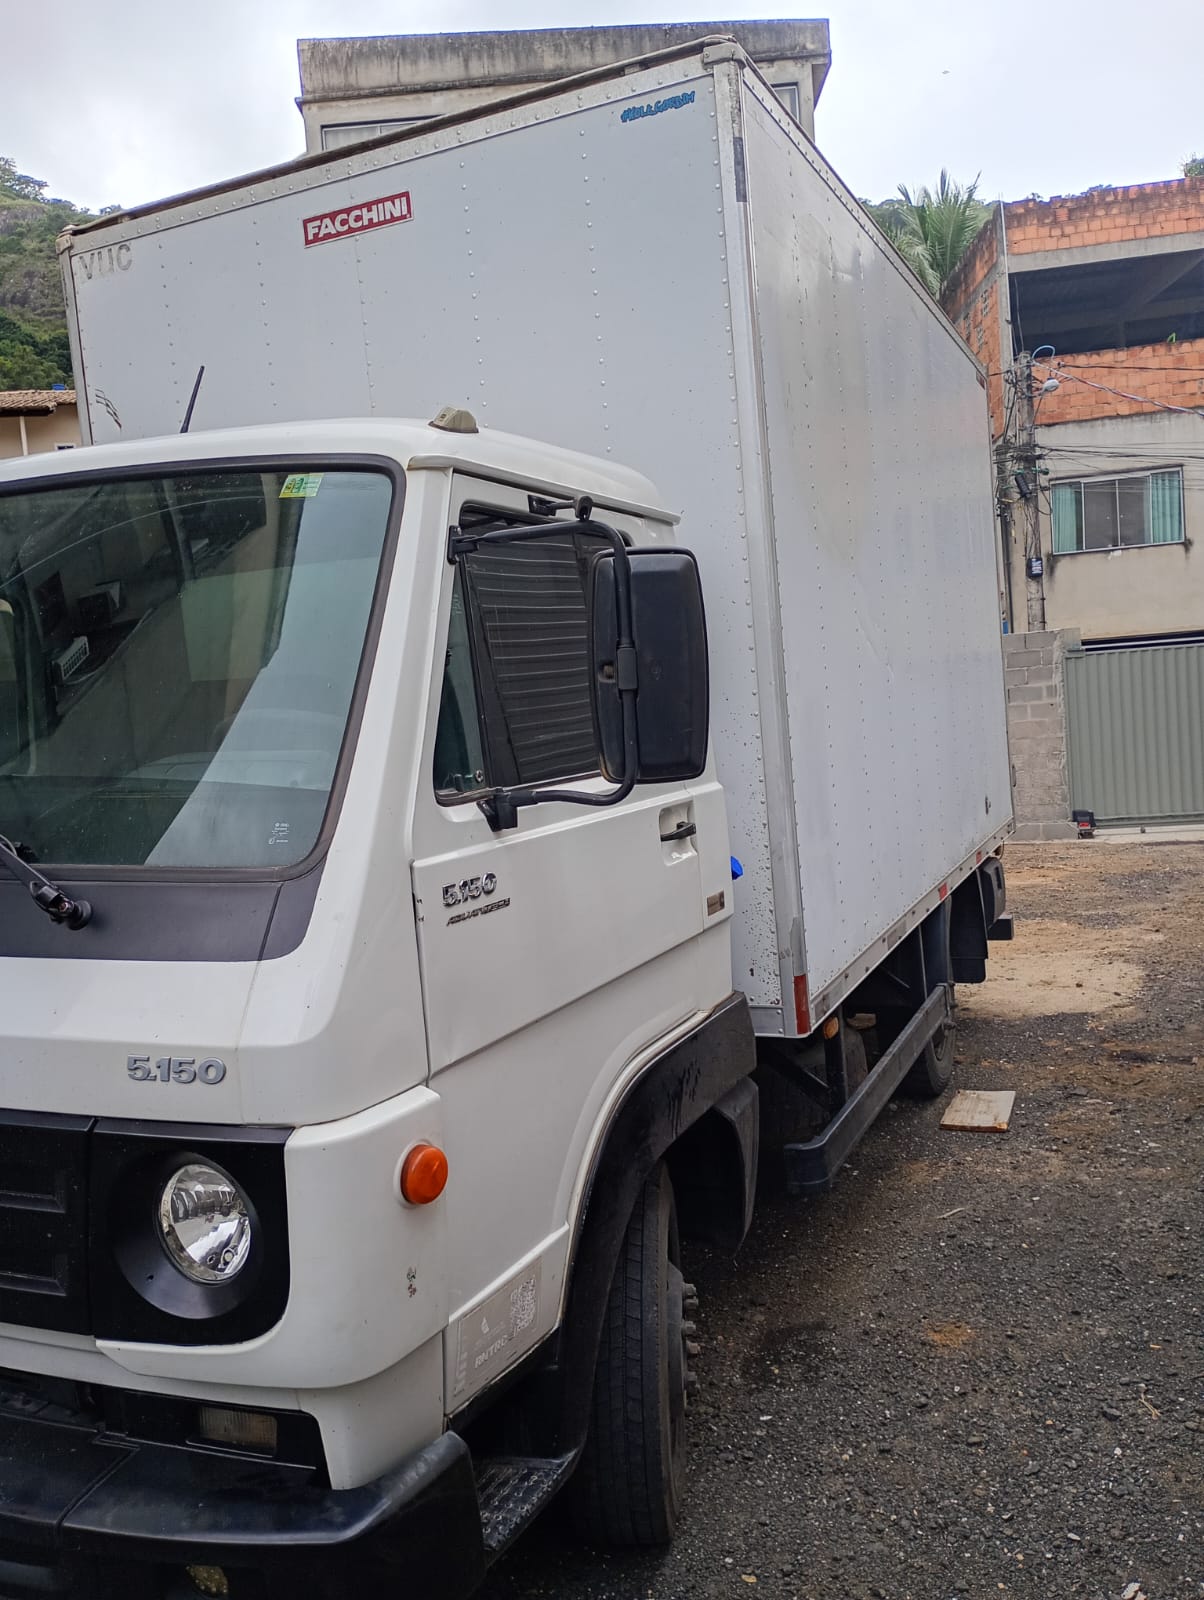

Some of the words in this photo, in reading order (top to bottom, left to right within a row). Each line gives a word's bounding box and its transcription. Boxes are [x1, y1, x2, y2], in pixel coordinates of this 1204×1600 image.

[306, 196, 408, 241] FACCHINI
[442, 871, 498, 908] 5.150
[127, 1054, 227, 1085] 5.150
